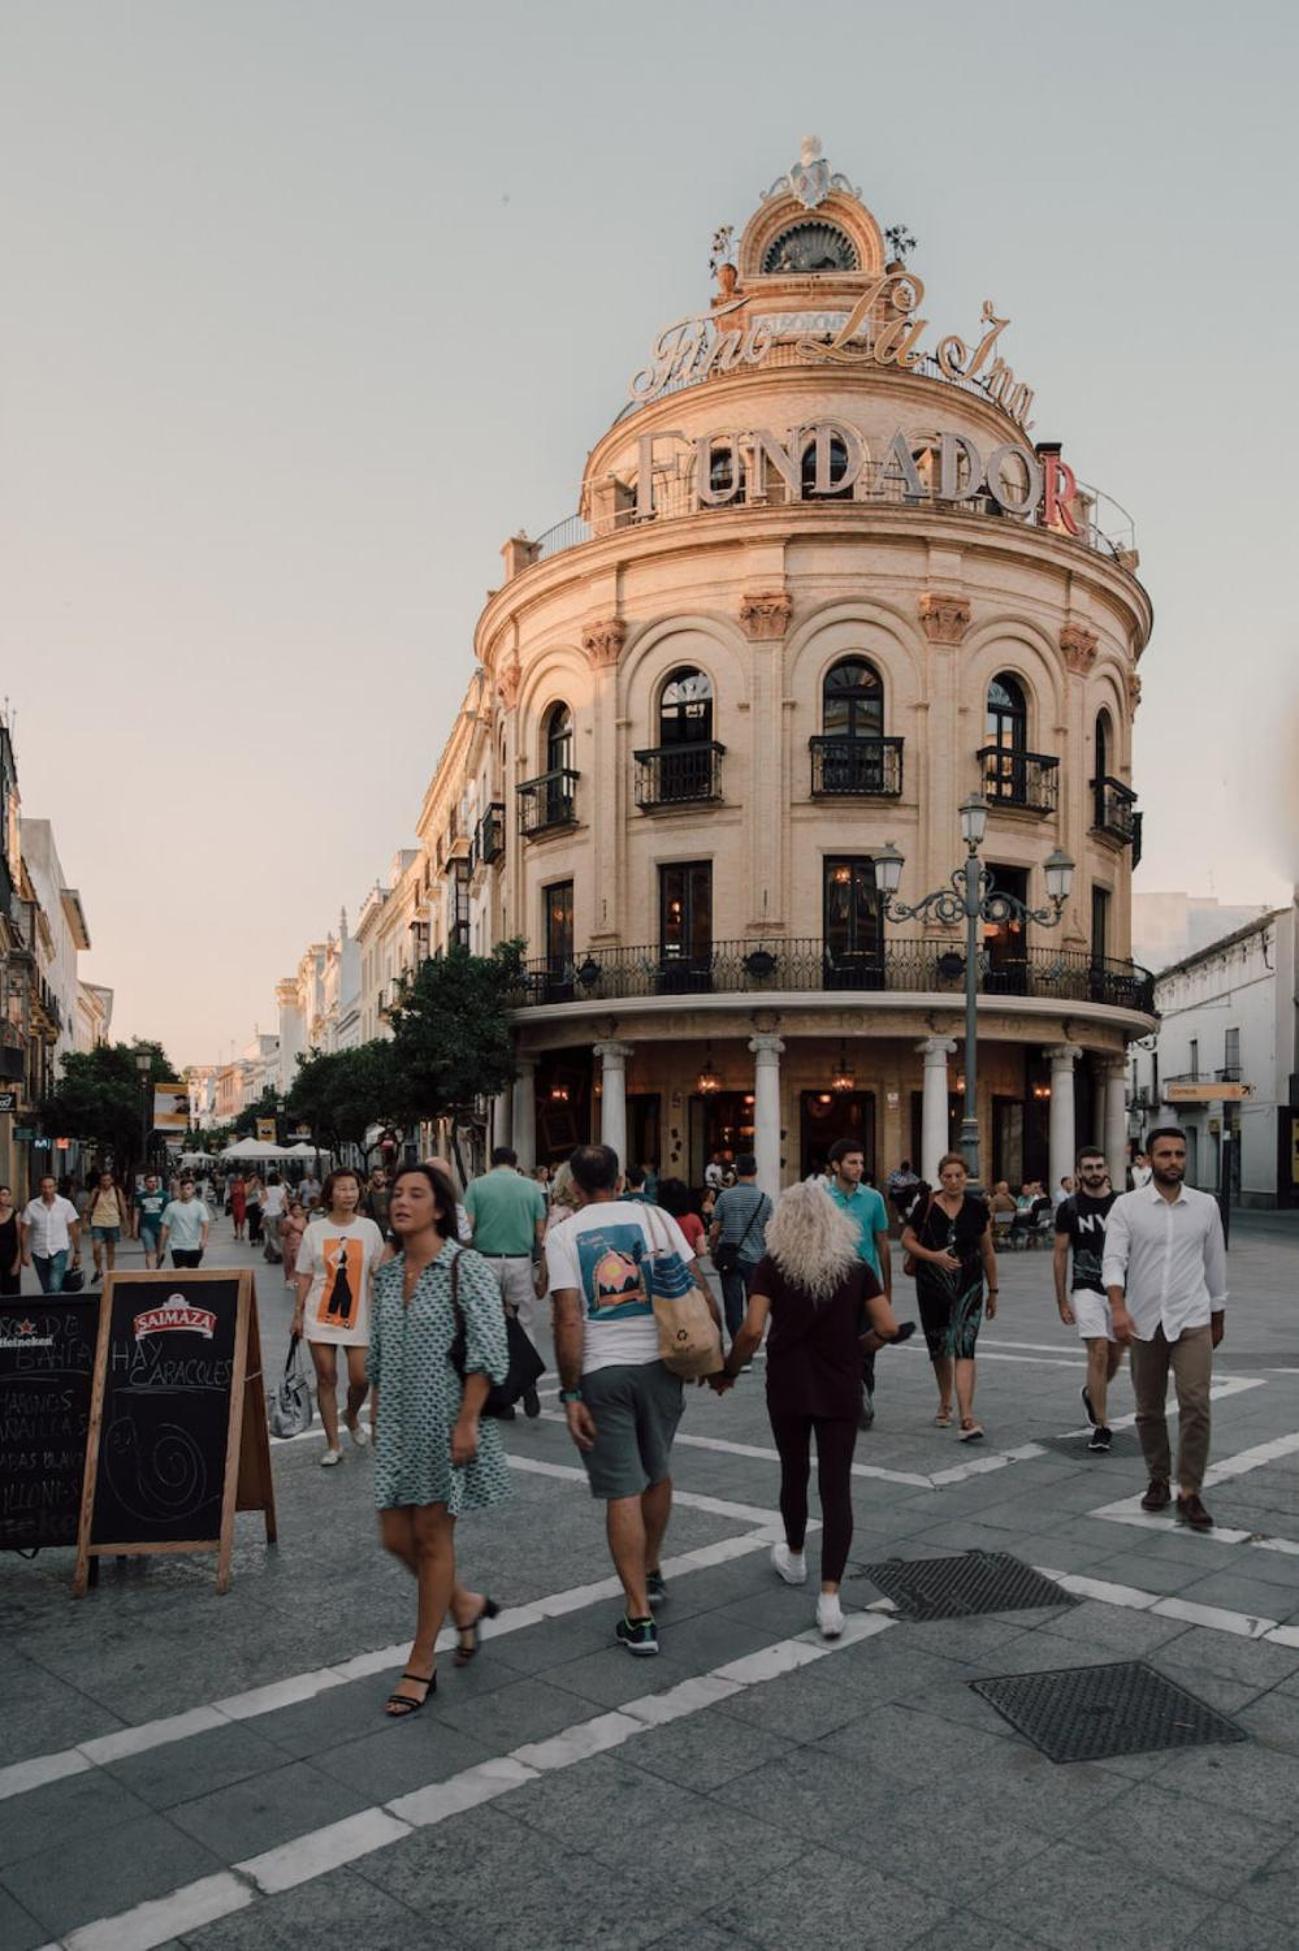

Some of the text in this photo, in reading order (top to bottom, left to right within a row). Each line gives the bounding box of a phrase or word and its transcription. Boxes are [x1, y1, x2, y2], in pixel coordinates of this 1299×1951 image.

[796, 271, 930, 368] La
[635, 421, 1083, 537] FUNDADOR
[138, 1309, 210, 1330] SAIMAZA
[112, 1338, 164, 1372] HAY
